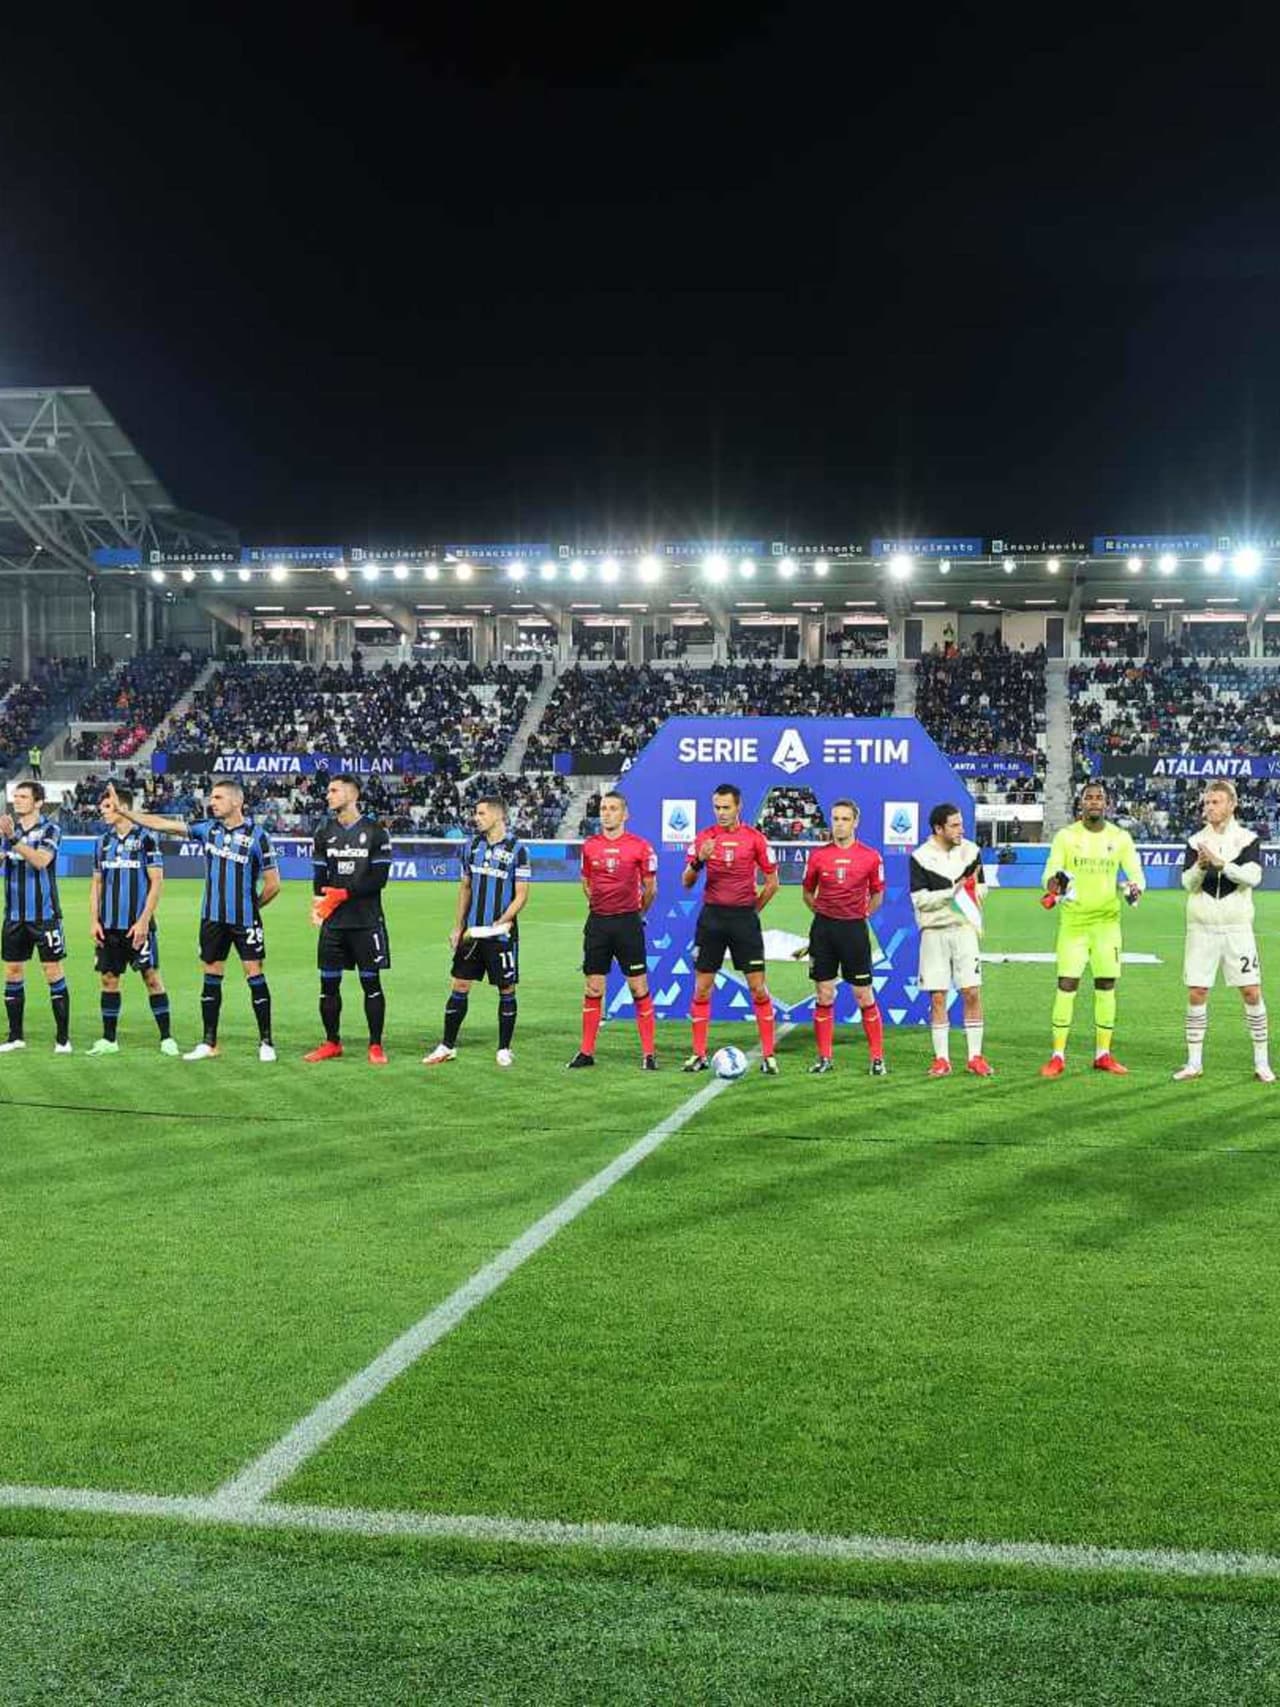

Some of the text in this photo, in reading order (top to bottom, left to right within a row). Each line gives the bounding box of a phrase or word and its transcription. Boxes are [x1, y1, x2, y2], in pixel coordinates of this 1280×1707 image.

[678, 738, 758, 763] SERIE
[213, 757, 394, 773] ATALANTA VS MILAN
[949, 762, 976, 771] ANTA
[1153, 758, 1252, 775] ATALANTA
[431, 864, 446, 875] VS
[45, 930, 61, 947] 15
[372, 933, 380, 952] 1
[499, 951, 515, 968] 11
